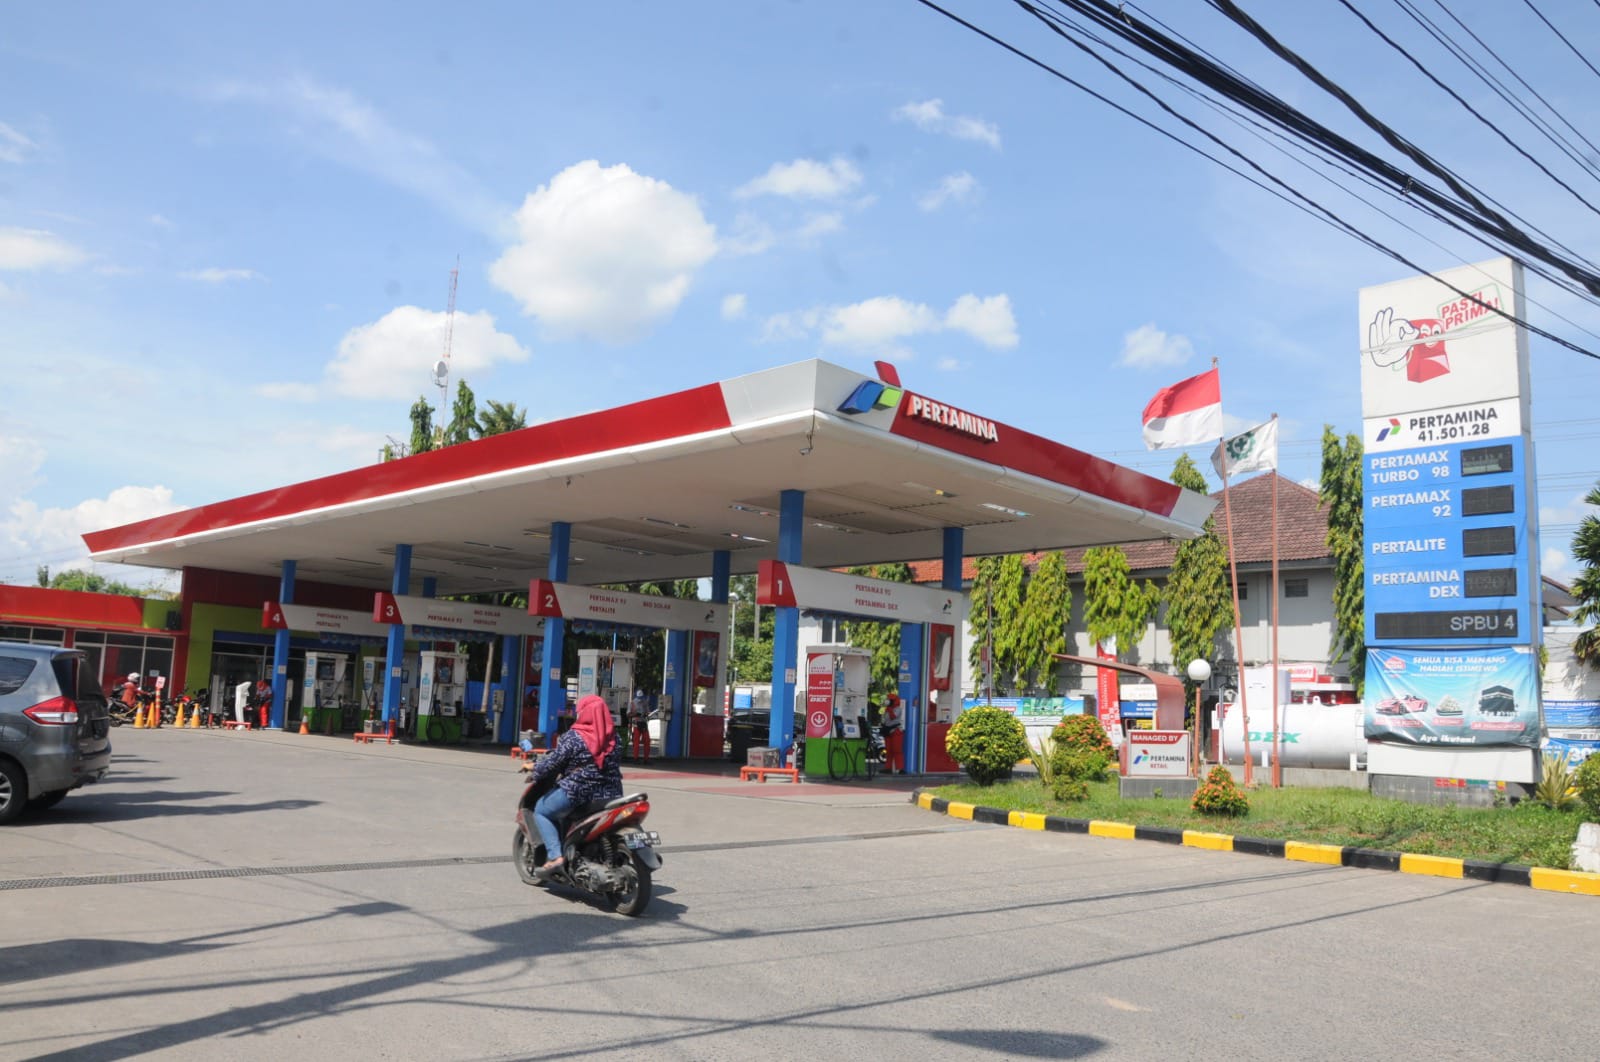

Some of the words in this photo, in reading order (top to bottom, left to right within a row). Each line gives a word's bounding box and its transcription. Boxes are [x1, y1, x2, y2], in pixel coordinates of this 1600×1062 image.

[1441, 291, 1484, 318] PASTI
[1445, 298, 1499, 331] PRIMA!
[908, 395, 999, 442] PERTAMINA
[1410, 408, 1498, 430] PERTAMINA
[1418, 423, 1490, 442] 41.501.28
[1371, 450, 1449, 469] PERTAMAX
[1372, 470, 1419, 484] TURBO
[1431, 466, 1450, 479] 98
[1372, 490, 1451, 508] PERTAMAX
[1432, 505, 1452, 518] 92
[1372, 538, 1446, 554] PERTALITE
[1372, 569, 1460, 585] PERTAMINA
[777, 579, 783, 596] 1
[1430, 585, 1460, 598] DEX
[545, 595, 554, 608] 2
[272, 613, 280, 623] 4
[386, 605, 394, 617] 3
[1450, 616, 1498, 631] SPBU
[1504, 616, 1515, 630] 4
[1412, 656, 1441, 664] SEMUA
[1242, 731, 1302, 743] DEX
[1150, 755, 1186, 763] PERTAMINA
